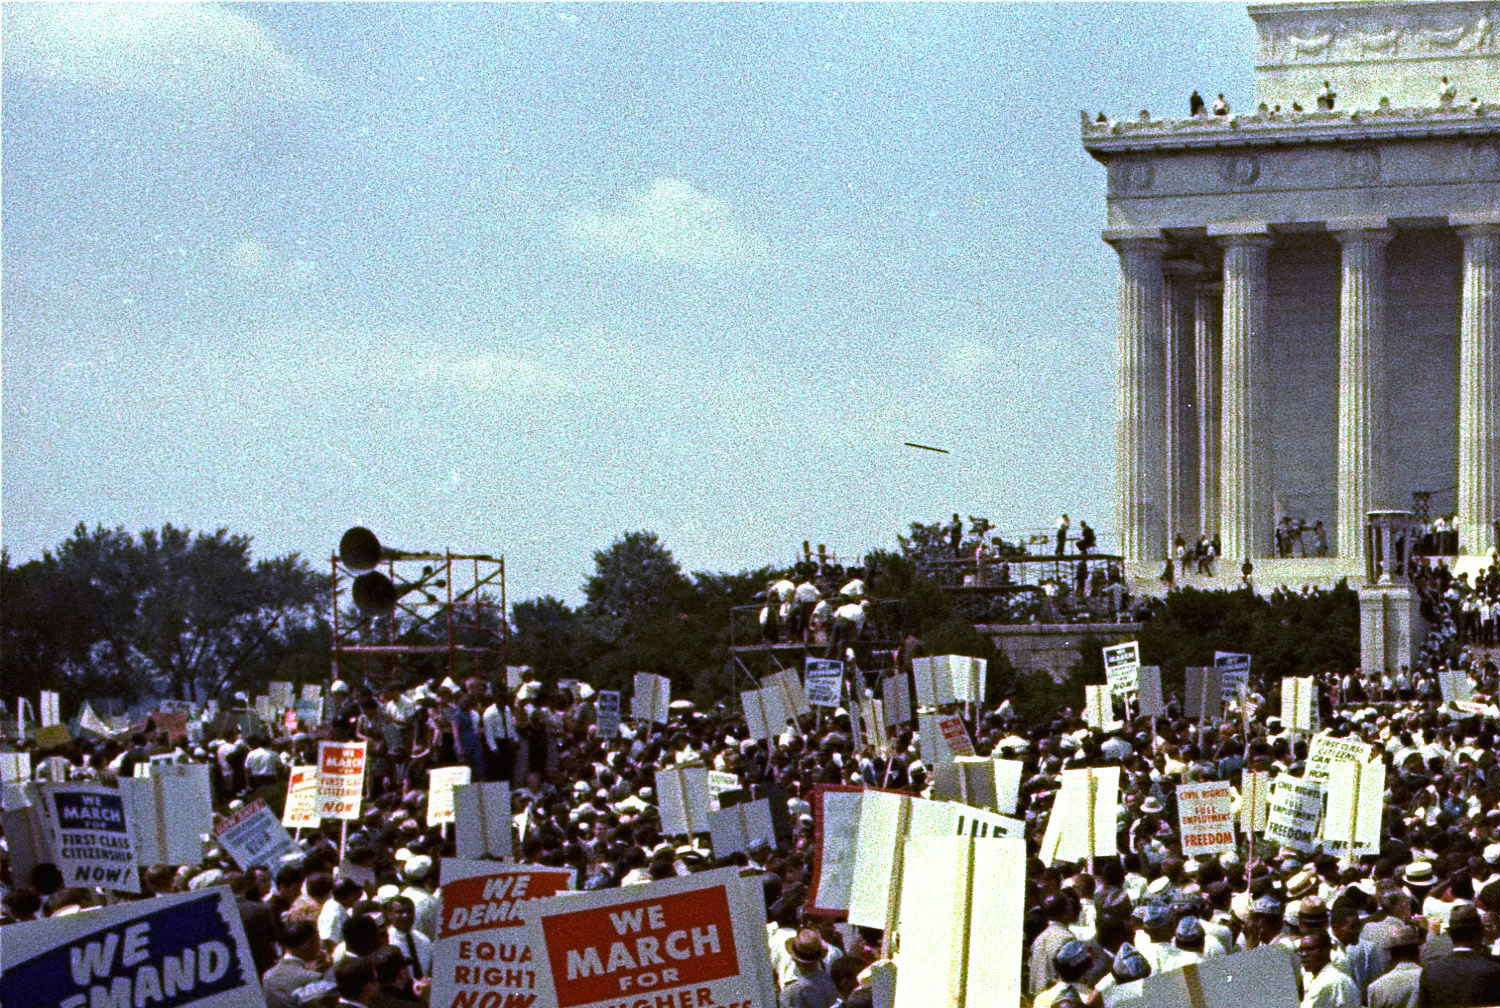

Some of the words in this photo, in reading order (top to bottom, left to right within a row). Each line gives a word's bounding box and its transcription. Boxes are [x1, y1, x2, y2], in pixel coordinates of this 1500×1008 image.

[82, 796, 102, 807] WE
[63, 806, 121, 824] MARCH
[62, 834, 96, 846] FIRST
[99, 835, 130, 850] CLASS
[1184, 832, 1233, 847] FREEDOM
[1269, 822, 1312, 842] FREEDOM
[62, 848, 132, 862] CITIZENSHIP
[75, 866, 131, 885] NOW!
[482, 875, 531, 900] WE
[448, 896, 530, 929] DEMA
[610, 904, 666, 936] WE
[70, 921, 151, 987] WE
[458, 941, 532, 962] EQUA
[566, 925, 721, 981] MARCH
[454, 965, 535, 990] RIGHT
[619, 969, 681, 991] FOR
